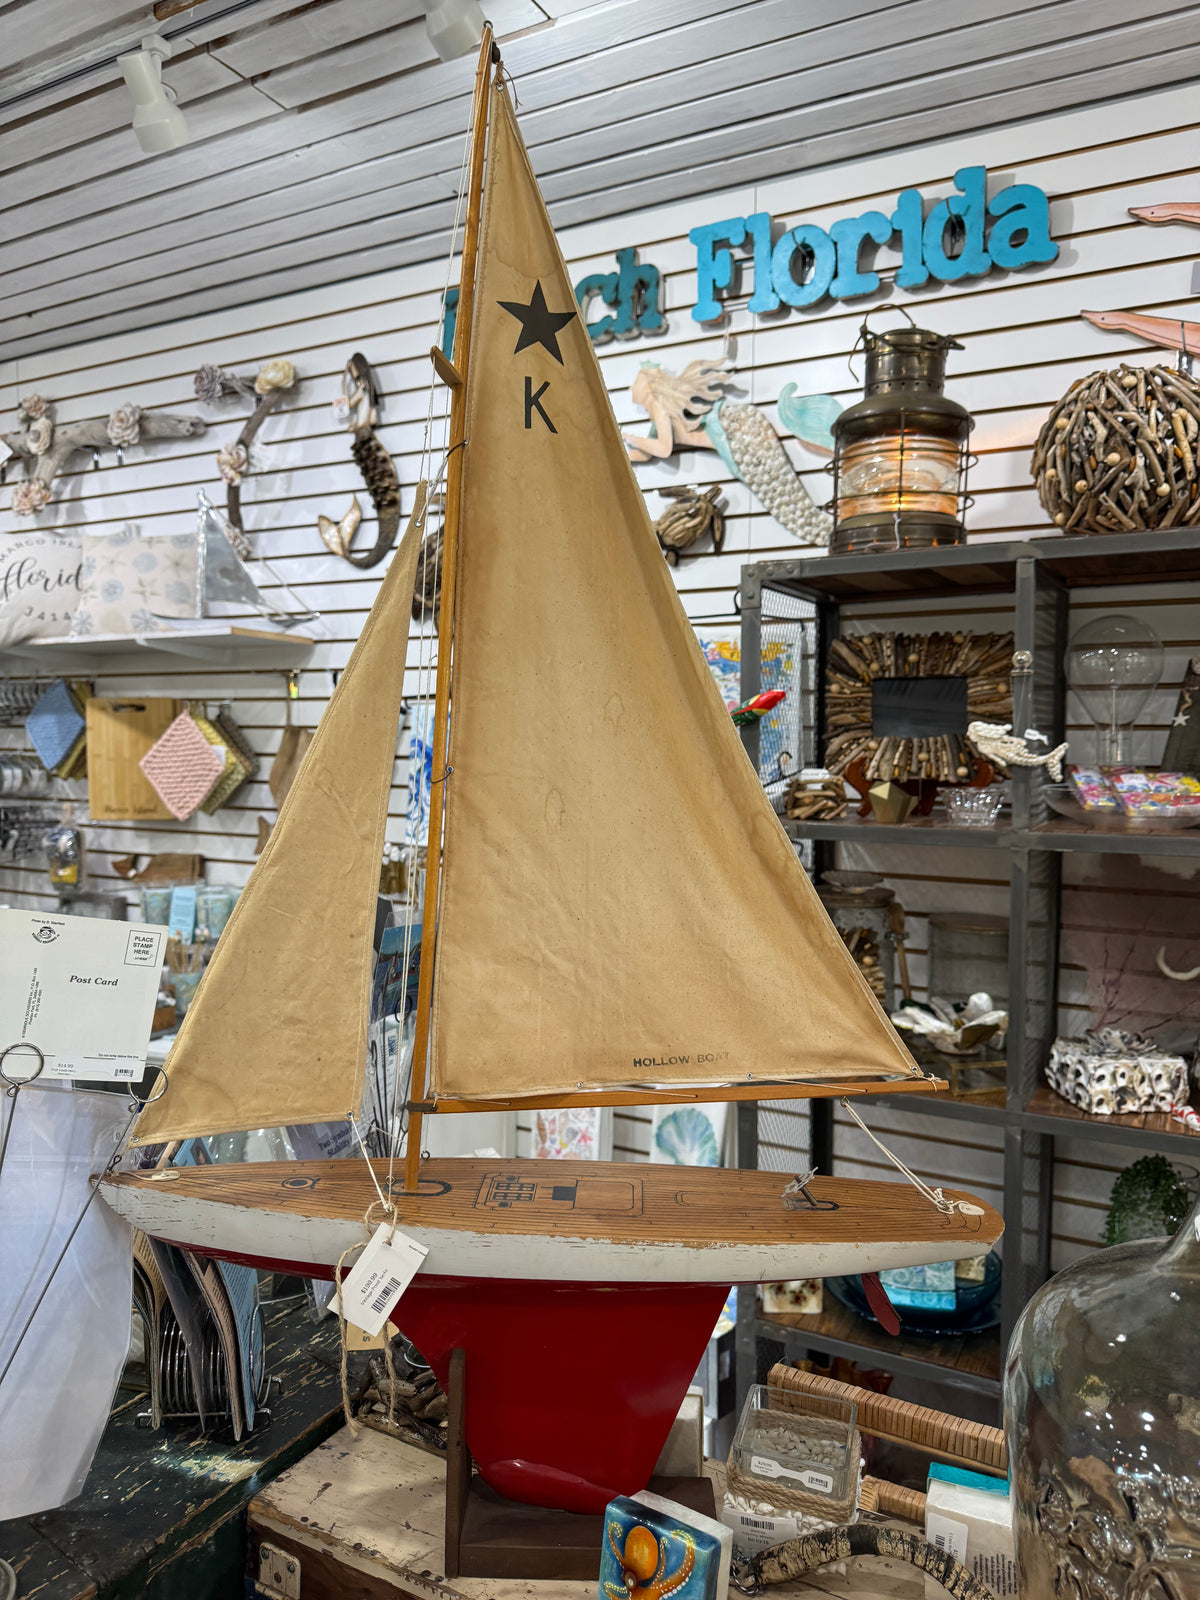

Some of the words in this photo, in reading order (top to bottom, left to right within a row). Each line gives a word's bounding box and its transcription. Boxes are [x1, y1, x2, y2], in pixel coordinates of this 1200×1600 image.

[689, 165, 1060, 323] Florida
[525, 376, 558, 434] K
[0, 557, 83, 602] florid
[70, 975, 92, 984] Post
[94, 977, 119, 986] Card
[633, 1055, 691, 1068] HOLLOW
